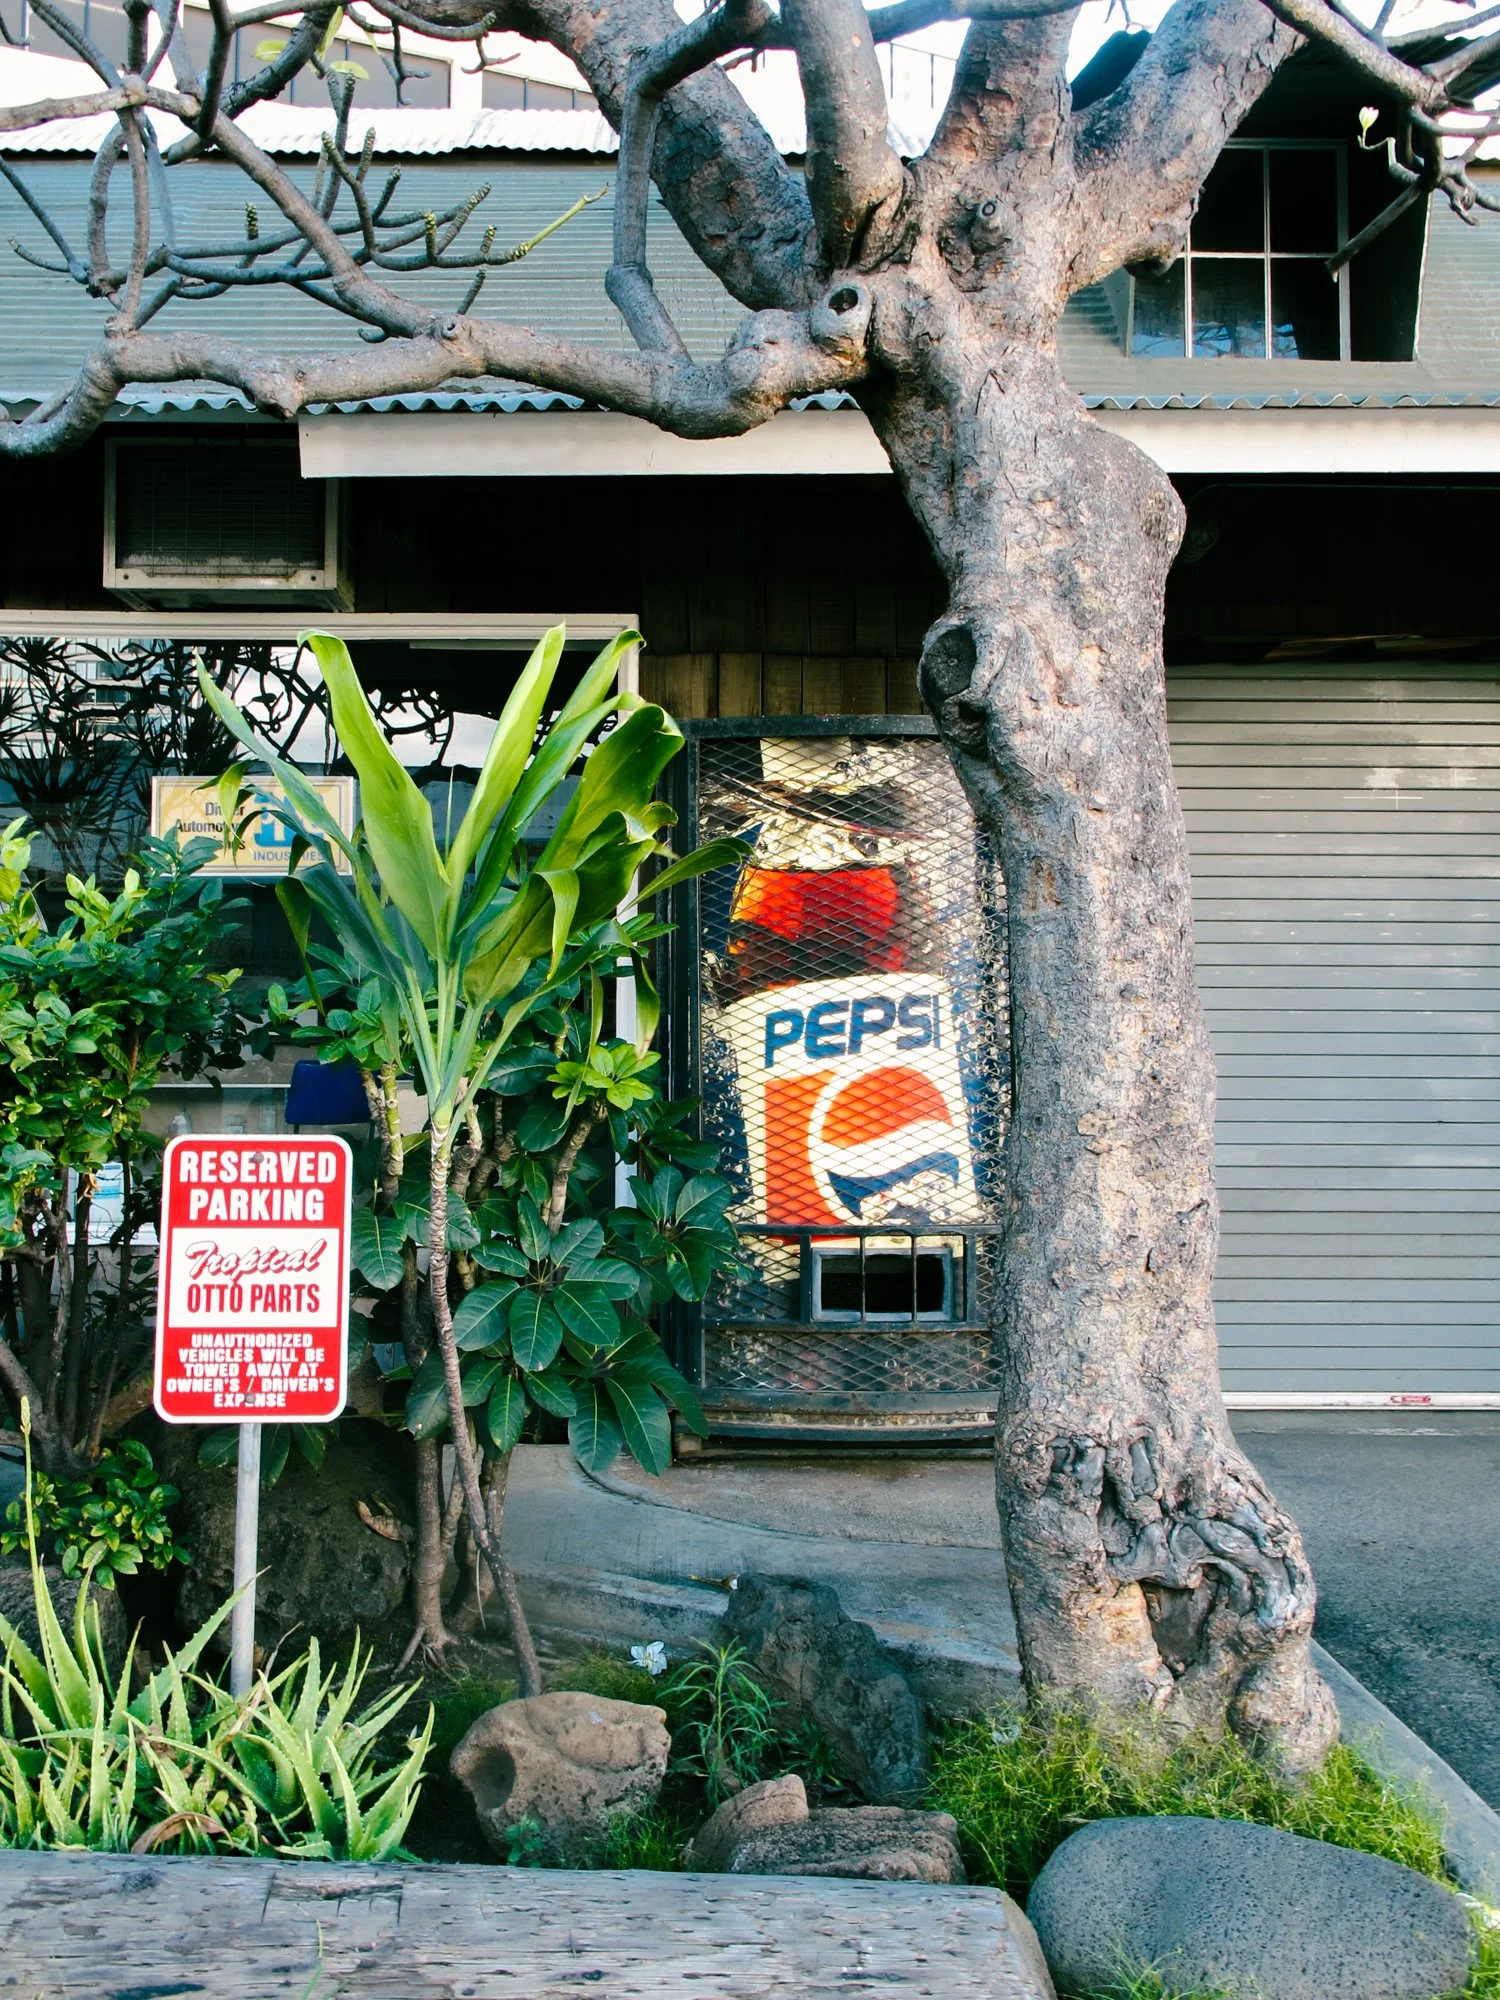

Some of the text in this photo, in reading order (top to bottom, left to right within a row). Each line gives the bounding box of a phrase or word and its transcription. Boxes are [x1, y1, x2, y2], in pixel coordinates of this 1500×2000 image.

[253, 850, 325, 861] INDUSIES
[764, 993, 942, 1069] PEPSI
[179, 1150, 338, 1184] RESERVED
[189, 1188, 326, 1222] PARKING
[185, 1238, 328, 1281] Tropical
[187, 1283, 320, 1313] OTTO PARTS
[191, 1333, 313, 1348] UNAUTHORIZED
[178, 1348, 325, 1363] VEHICLES WILL BE
[184, 1363, 319, 1378] TOWED AWAY AT
[166, 1378, 240, 1393] OWNER'S
[261, 1378, 335, 1393] DRIVER'S
